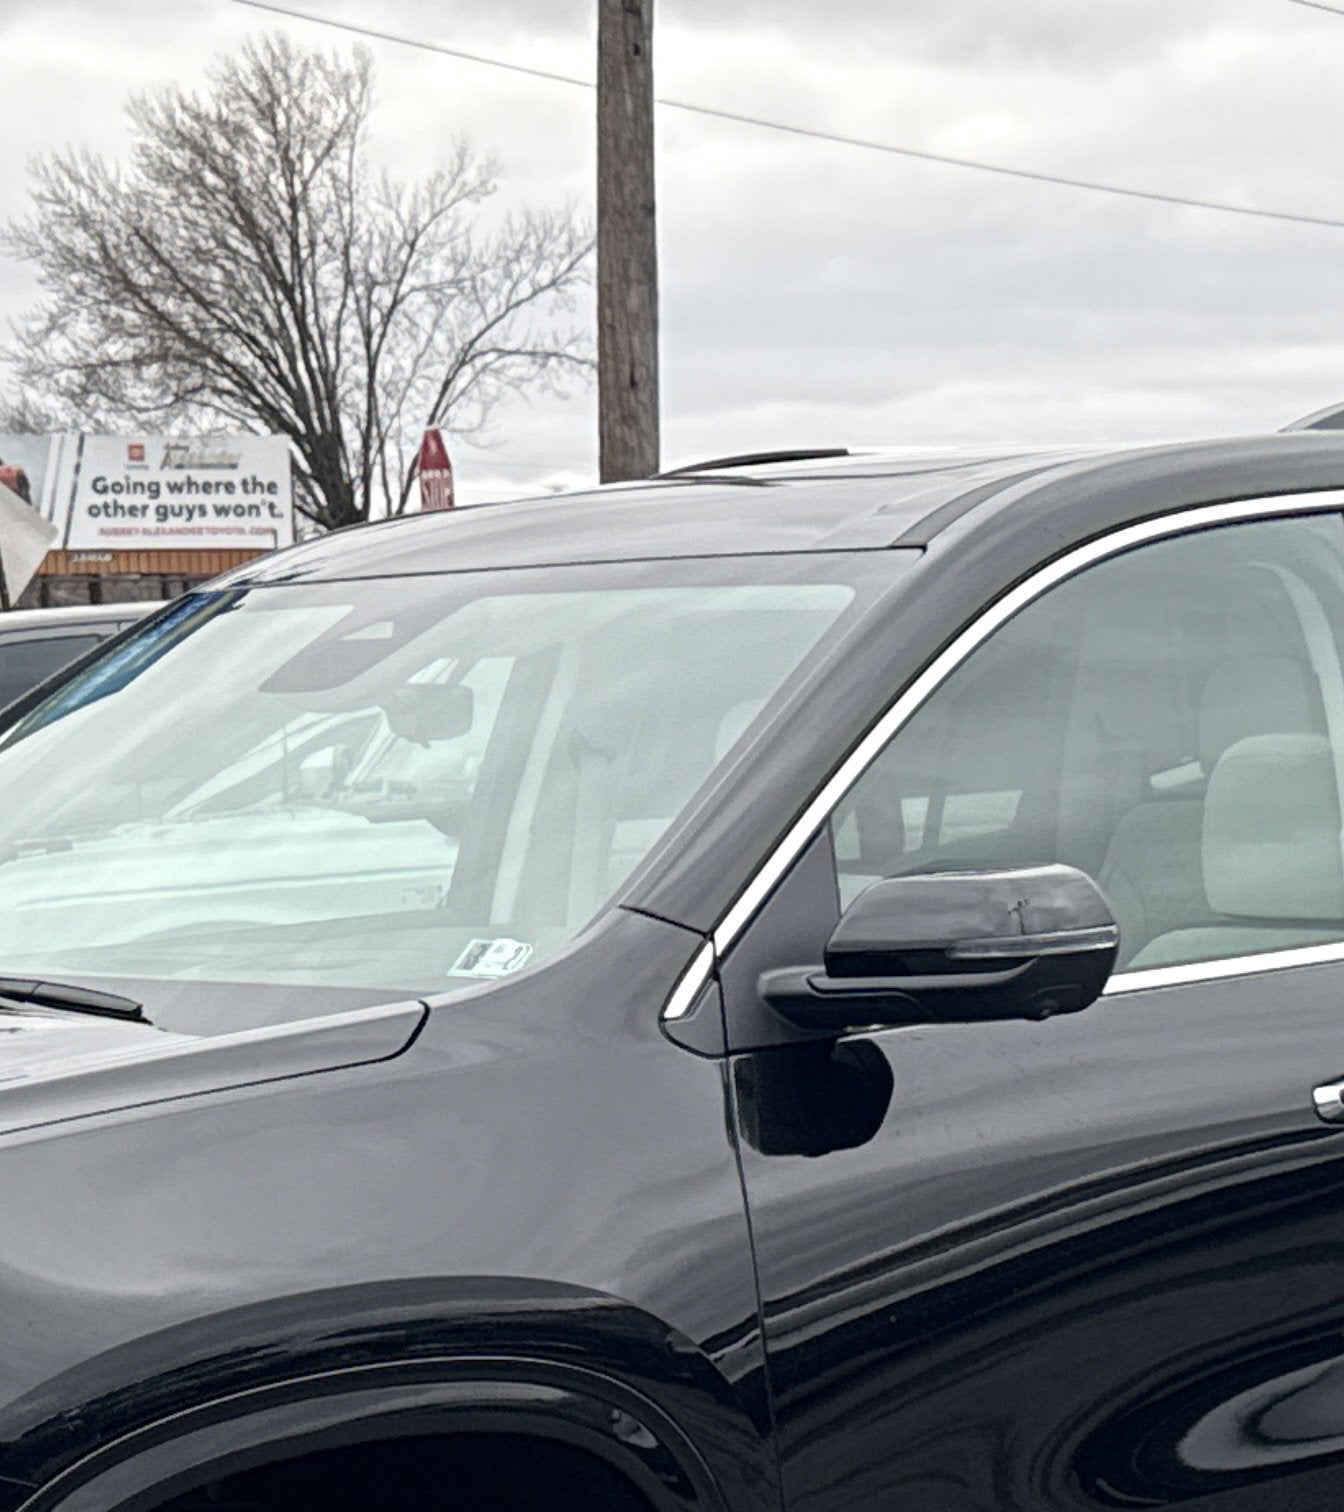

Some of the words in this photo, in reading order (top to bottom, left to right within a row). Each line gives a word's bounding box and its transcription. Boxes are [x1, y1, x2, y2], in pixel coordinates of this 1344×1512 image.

[91, 475, 160, 500] Going
[166, 474, 236, 496] where
[240, 474, 278, 496] the
[87, 498, 150, 518] other
[155, 502, 206, 523] guys
